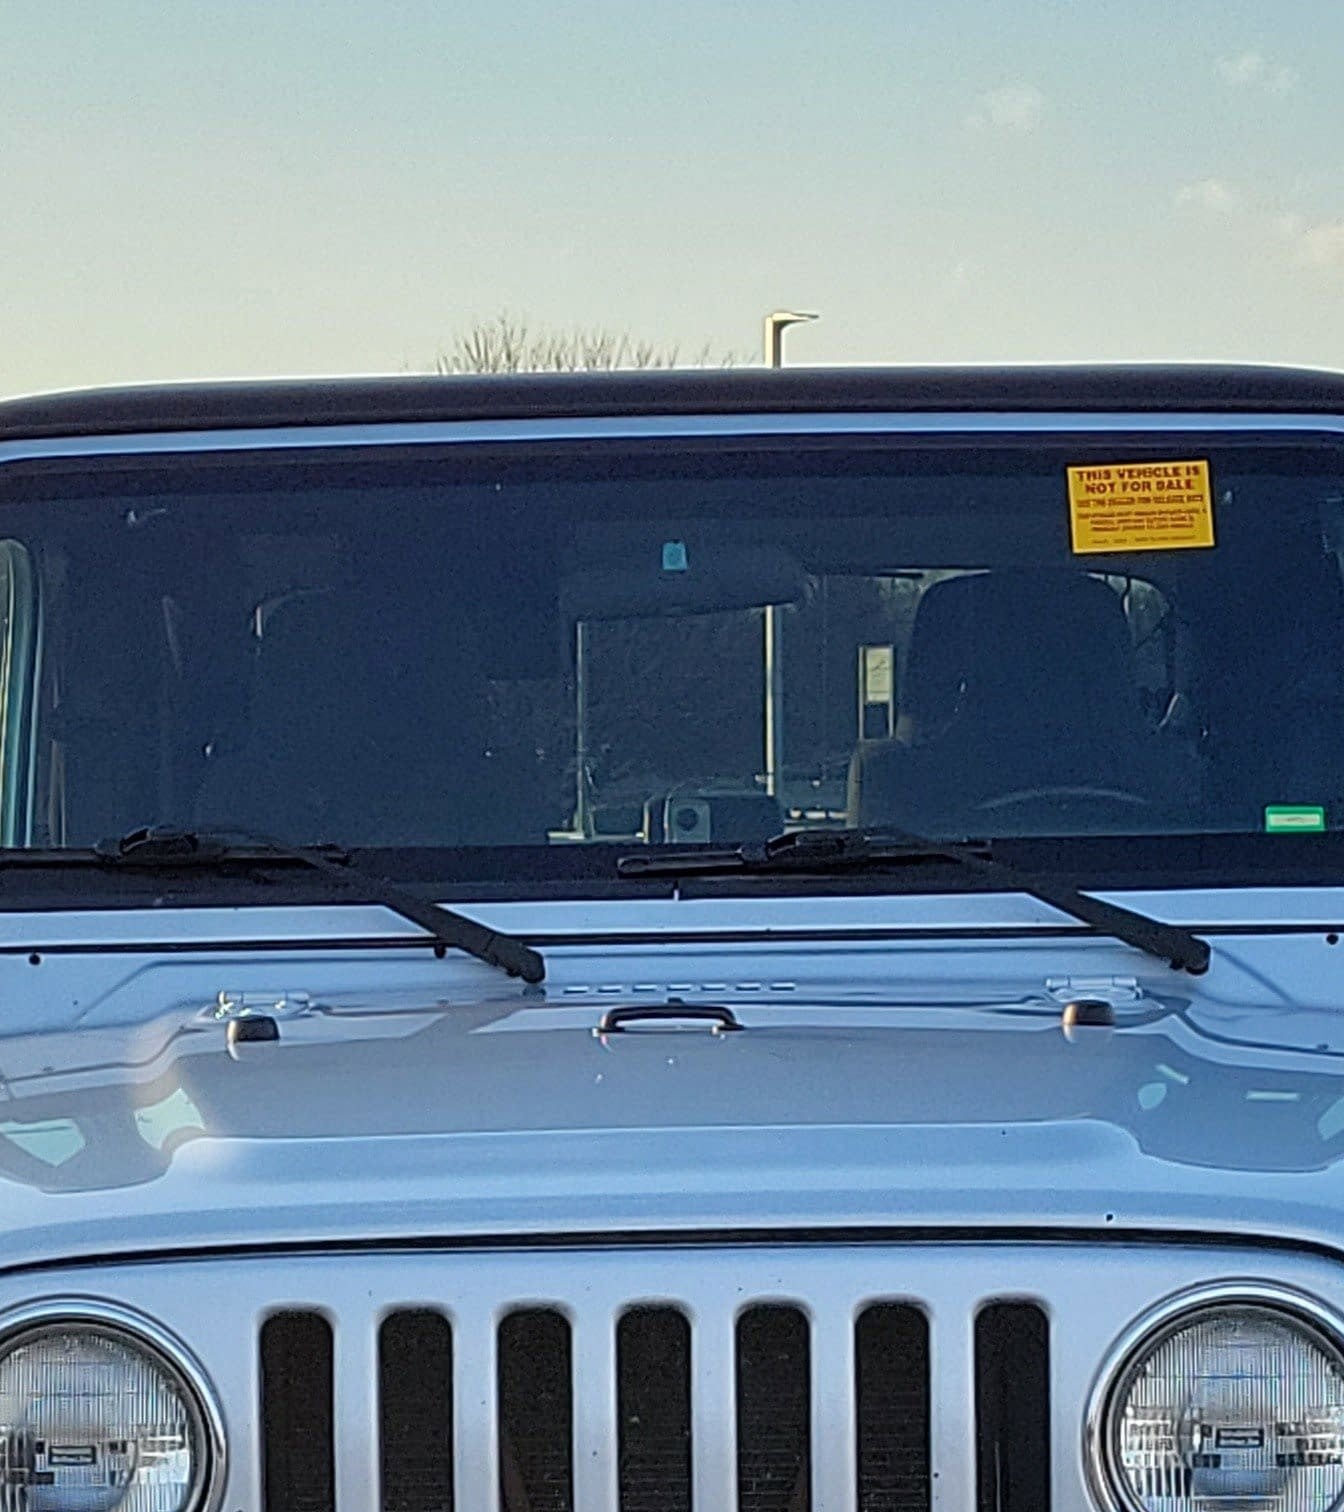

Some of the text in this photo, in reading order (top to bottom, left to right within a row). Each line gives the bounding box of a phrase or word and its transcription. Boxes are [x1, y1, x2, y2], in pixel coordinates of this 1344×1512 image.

[1077, 465, 1200, 481] THIS VEHICLE IS
[1085, 478, 1194, 494] NOT FOR SALE
